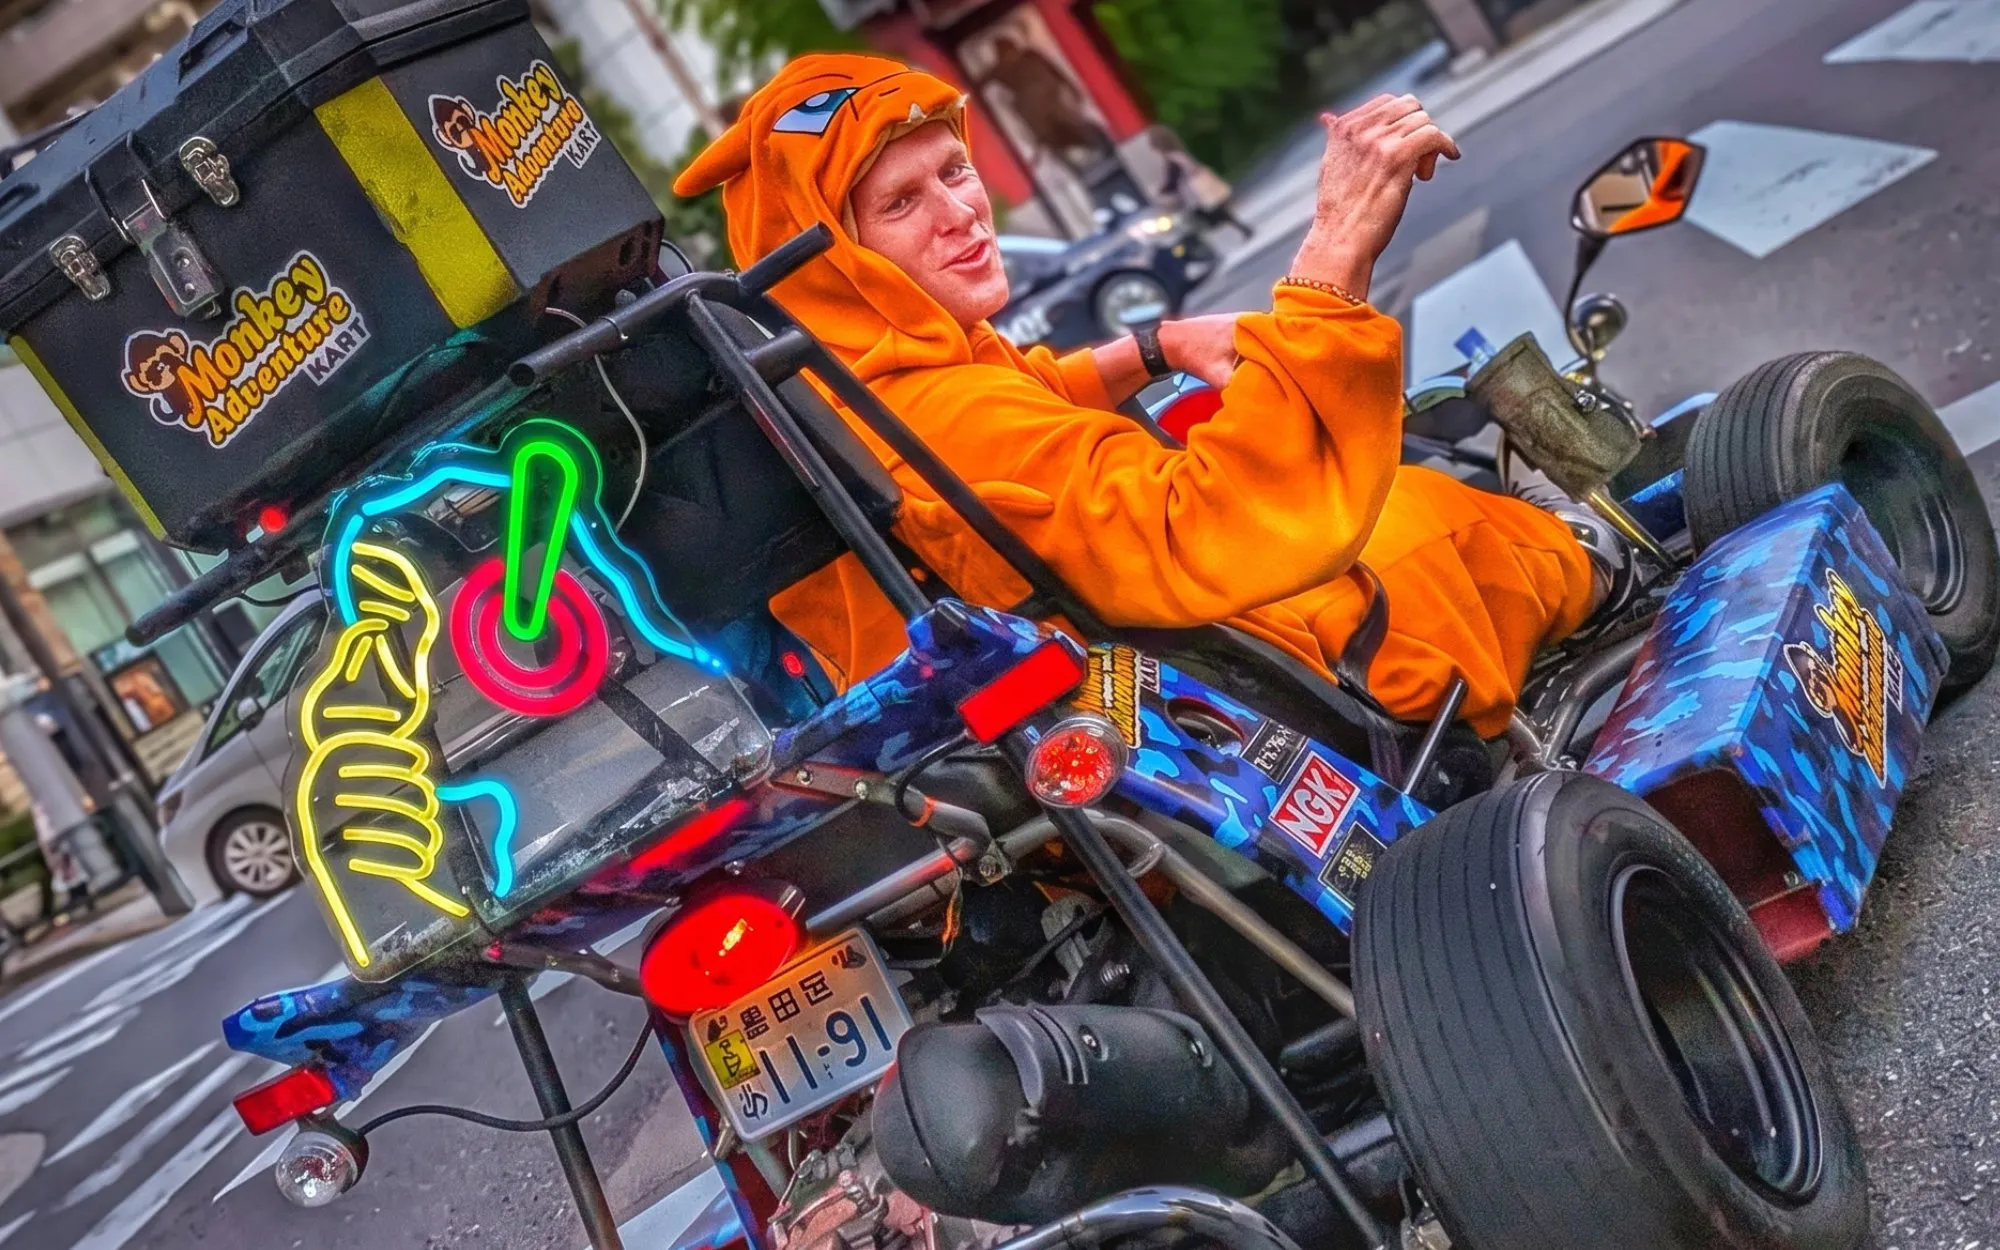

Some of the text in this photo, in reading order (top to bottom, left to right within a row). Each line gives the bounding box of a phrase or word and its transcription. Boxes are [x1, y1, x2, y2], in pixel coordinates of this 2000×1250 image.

[468, 62, 564, 185] Monkey
[564, 121, 599, 165] KART
[175, 254, 328, 428] Monkey
[205, 291, 351, 446] Adventure
[307, 317, 368, 381] KART
[1279, 767, 1344, 850] NGK
[759, 995, 892, 1104] 11-91
